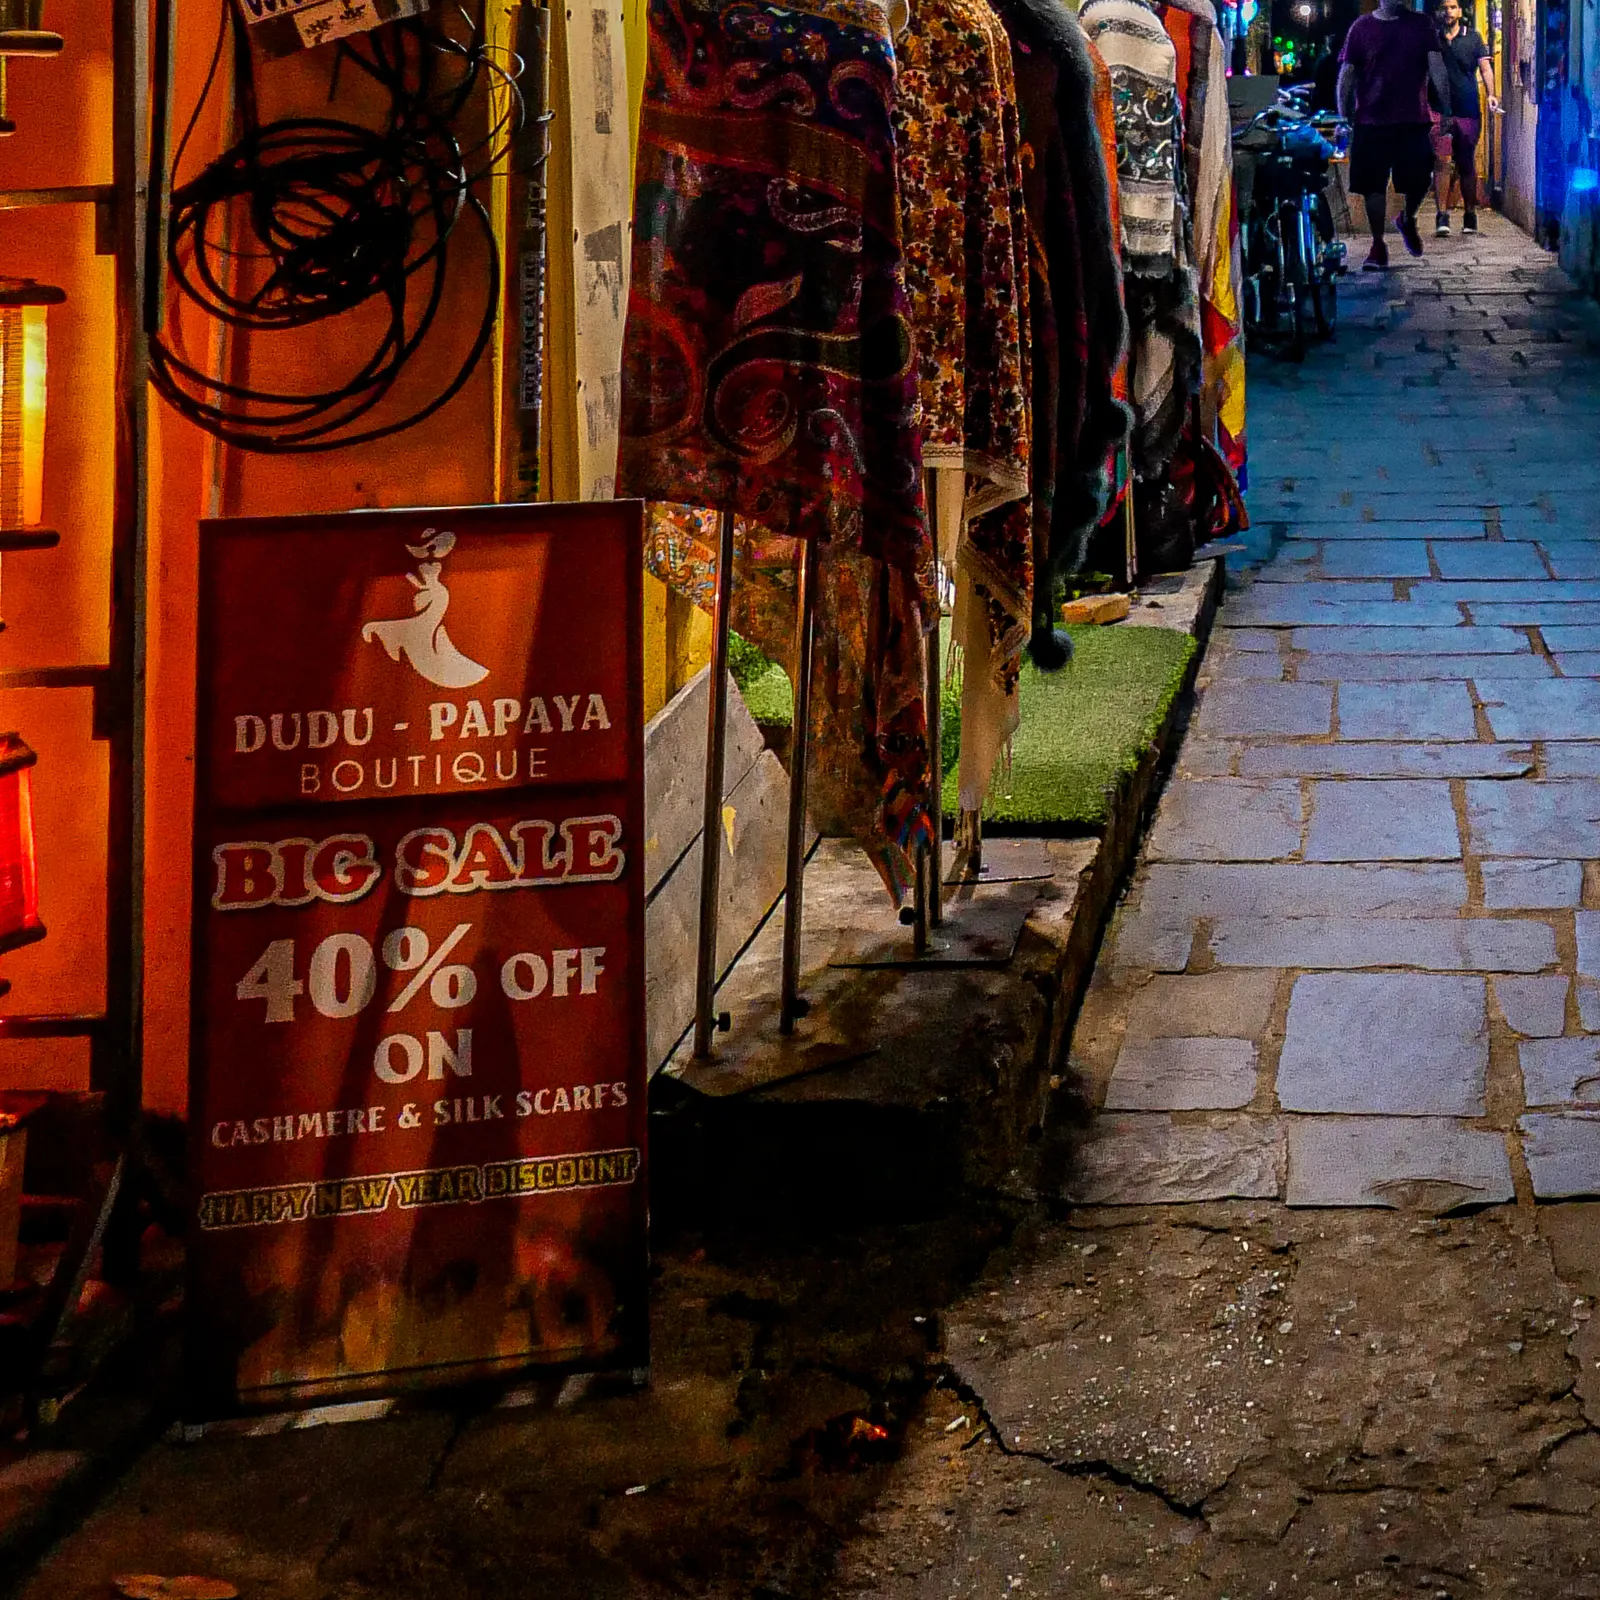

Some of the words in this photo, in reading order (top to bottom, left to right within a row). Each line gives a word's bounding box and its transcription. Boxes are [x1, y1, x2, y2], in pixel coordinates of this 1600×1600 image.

[234, 708, 374, 753] DUDU
[428, 694, 612, 740] PAPAYA
[300, 748, 548, 794] BOUTIQUE
[211, 834, 381, 911] BIG
[395, 814, 626, 897] SALE
[236, 923, 477, 1024] 40%
[501, 947, 606, 1000] OFF
[374, 1028, 473, 1084] ON
[211, 1106, 386, 1148] CASHMERE
[398, 1103, 421, 1129] &
[433, 1094, 504, 1126] SILK
[516, 1081, 629, 1117] SCARFS
[205, 1186, 308, 1225] HAPPY
[317, 1179, 388, 1215] NEW
[398, 1170, 478, 1203] YEAR
[488, 1153, 634, 1194] DISCOUNT
